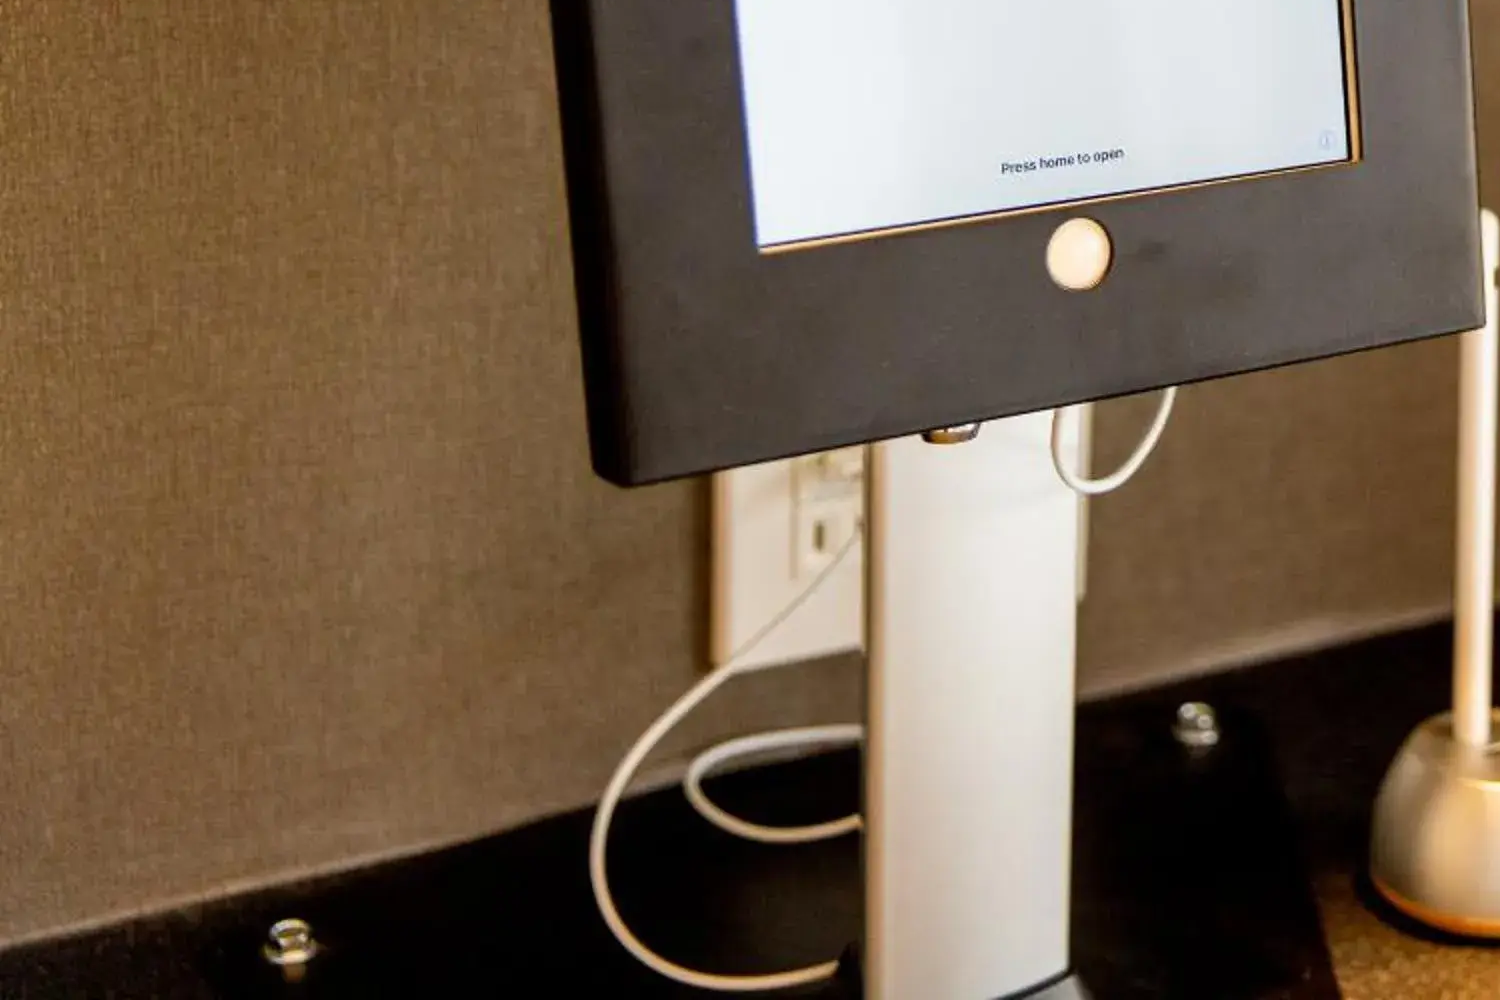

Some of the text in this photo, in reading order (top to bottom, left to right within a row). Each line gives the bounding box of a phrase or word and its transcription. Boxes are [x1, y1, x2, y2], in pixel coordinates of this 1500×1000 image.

[1000, 148, 1124, 175] Press home to open
